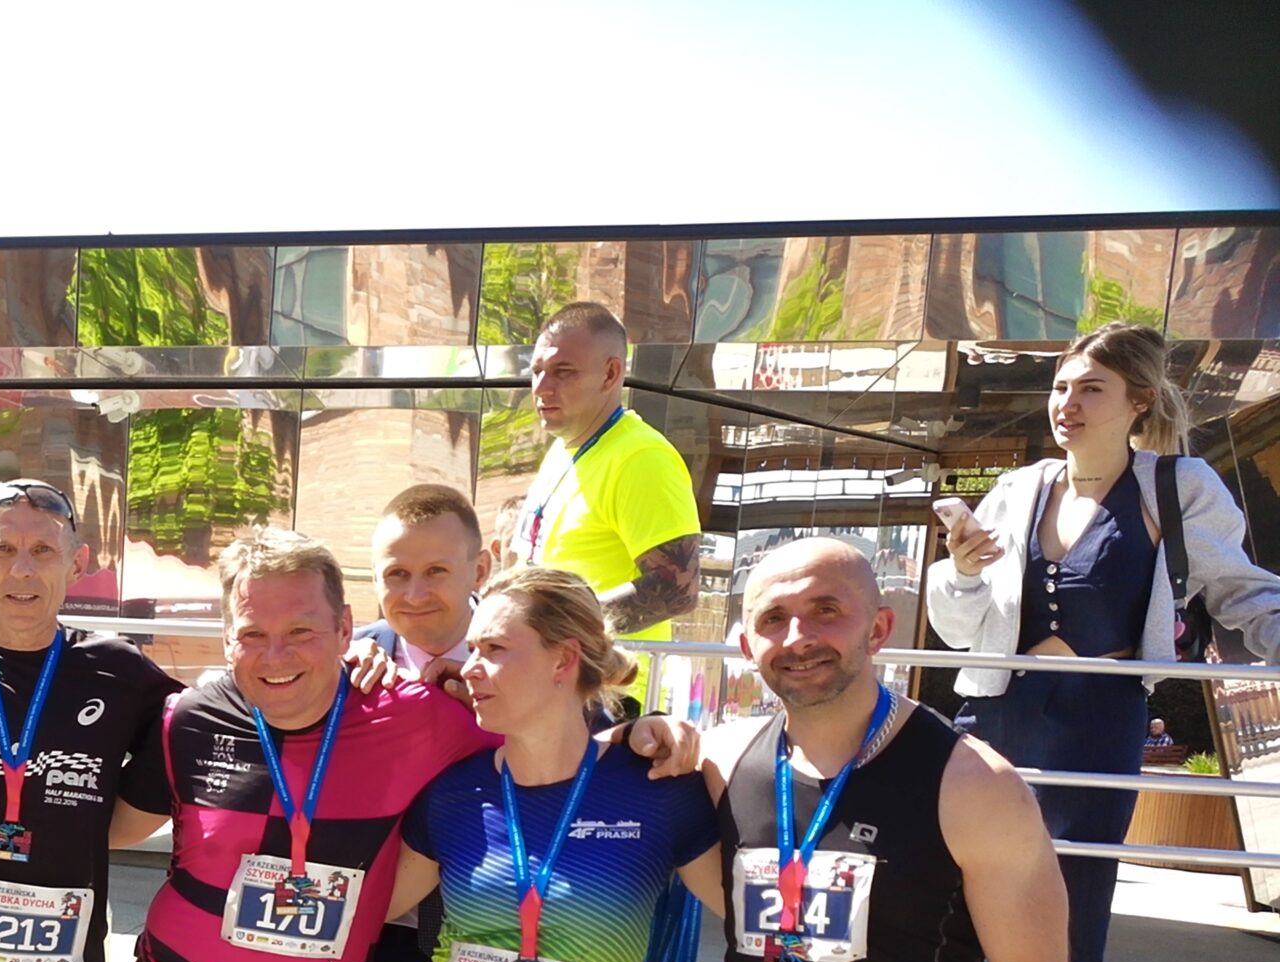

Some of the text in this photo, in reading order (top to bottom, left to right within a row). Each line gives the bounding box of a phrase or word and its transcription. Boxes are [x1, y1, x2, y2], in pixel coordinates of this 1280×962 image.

[46, 769, 99, 790] park
[596, 831, 641, 839] PRASKI
[245, 868, 286, 881] SZYBKA
[22, 898, 56, 909] DYCHA
